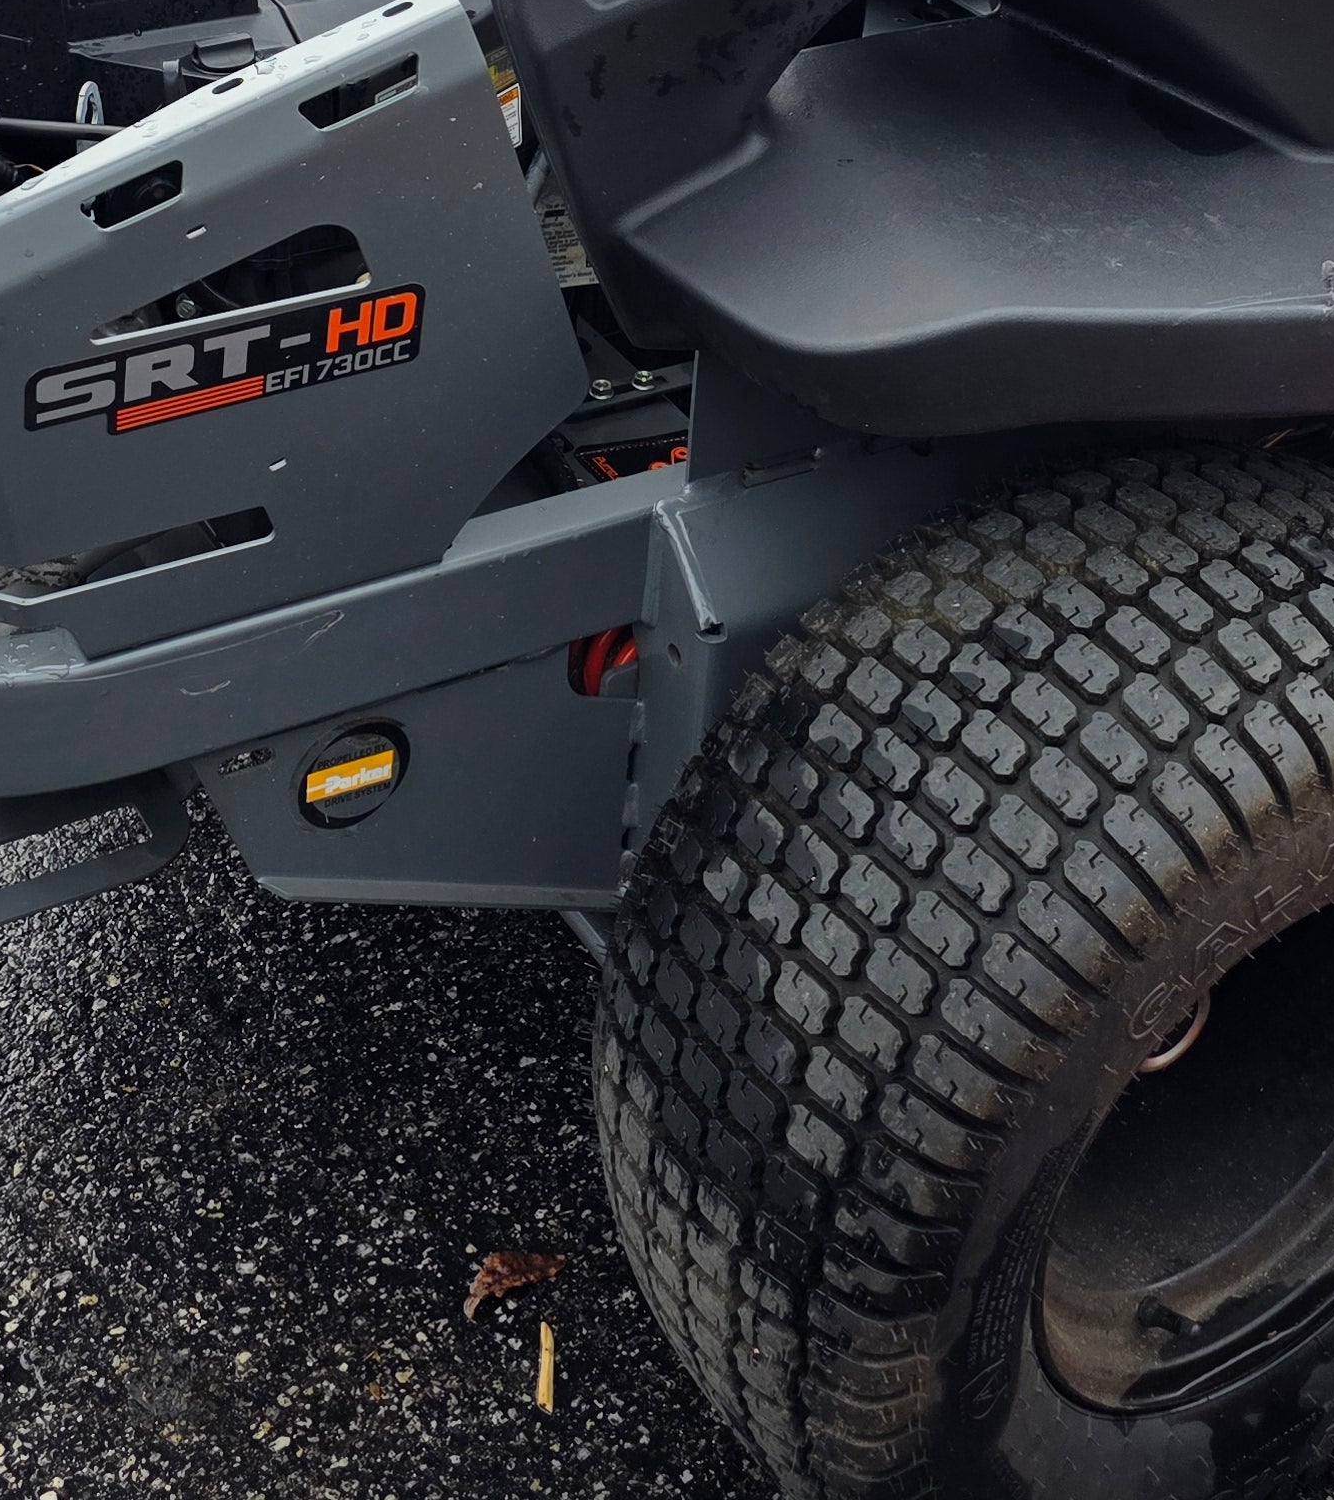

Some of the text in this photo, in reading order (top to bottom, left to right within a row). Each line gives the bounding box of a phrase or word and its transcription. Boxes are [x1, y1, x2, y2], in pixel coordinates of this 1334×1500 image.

[265, 339, 412, 394] EFI 730CC
[317, 742, 387, 769] PROPELLED BY
[325, 763, 392, 794] Parker
[324, 782, 391, 808] DRIVE SYSTEM
